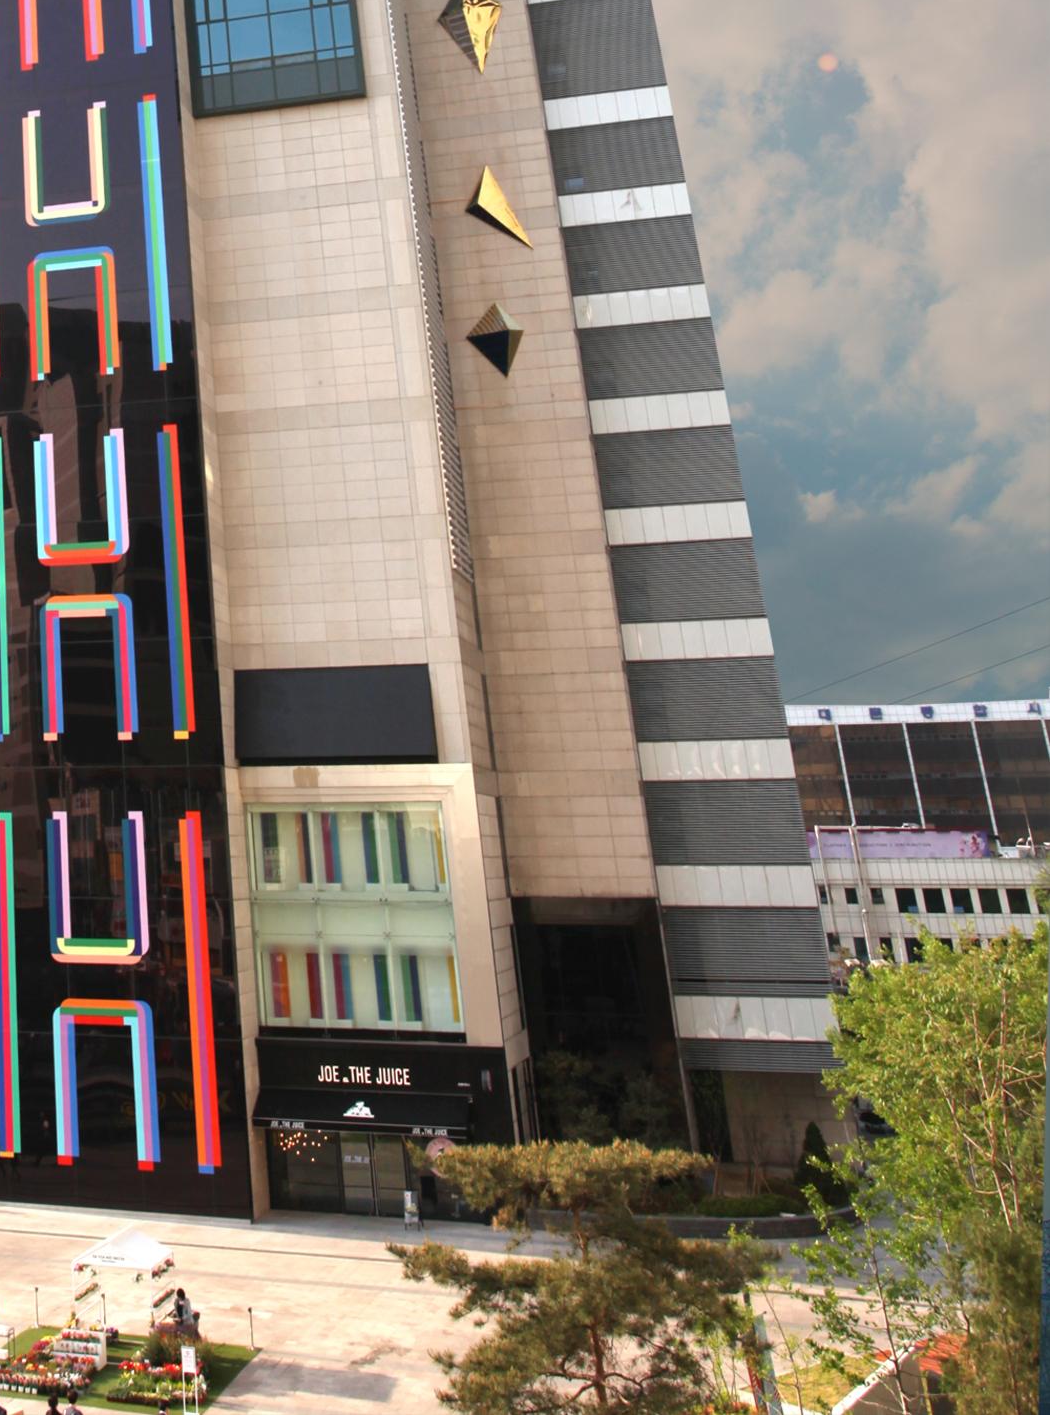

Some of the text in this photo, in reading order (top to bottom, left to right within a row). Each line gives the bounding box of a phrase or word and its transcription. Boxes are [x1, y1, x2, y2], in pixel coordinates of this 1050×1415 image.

[318, 1065, 340, 1082] JOE
[348, 1066, 372, 1084] THE
[376, 1067, 411, 1086] JUICE
